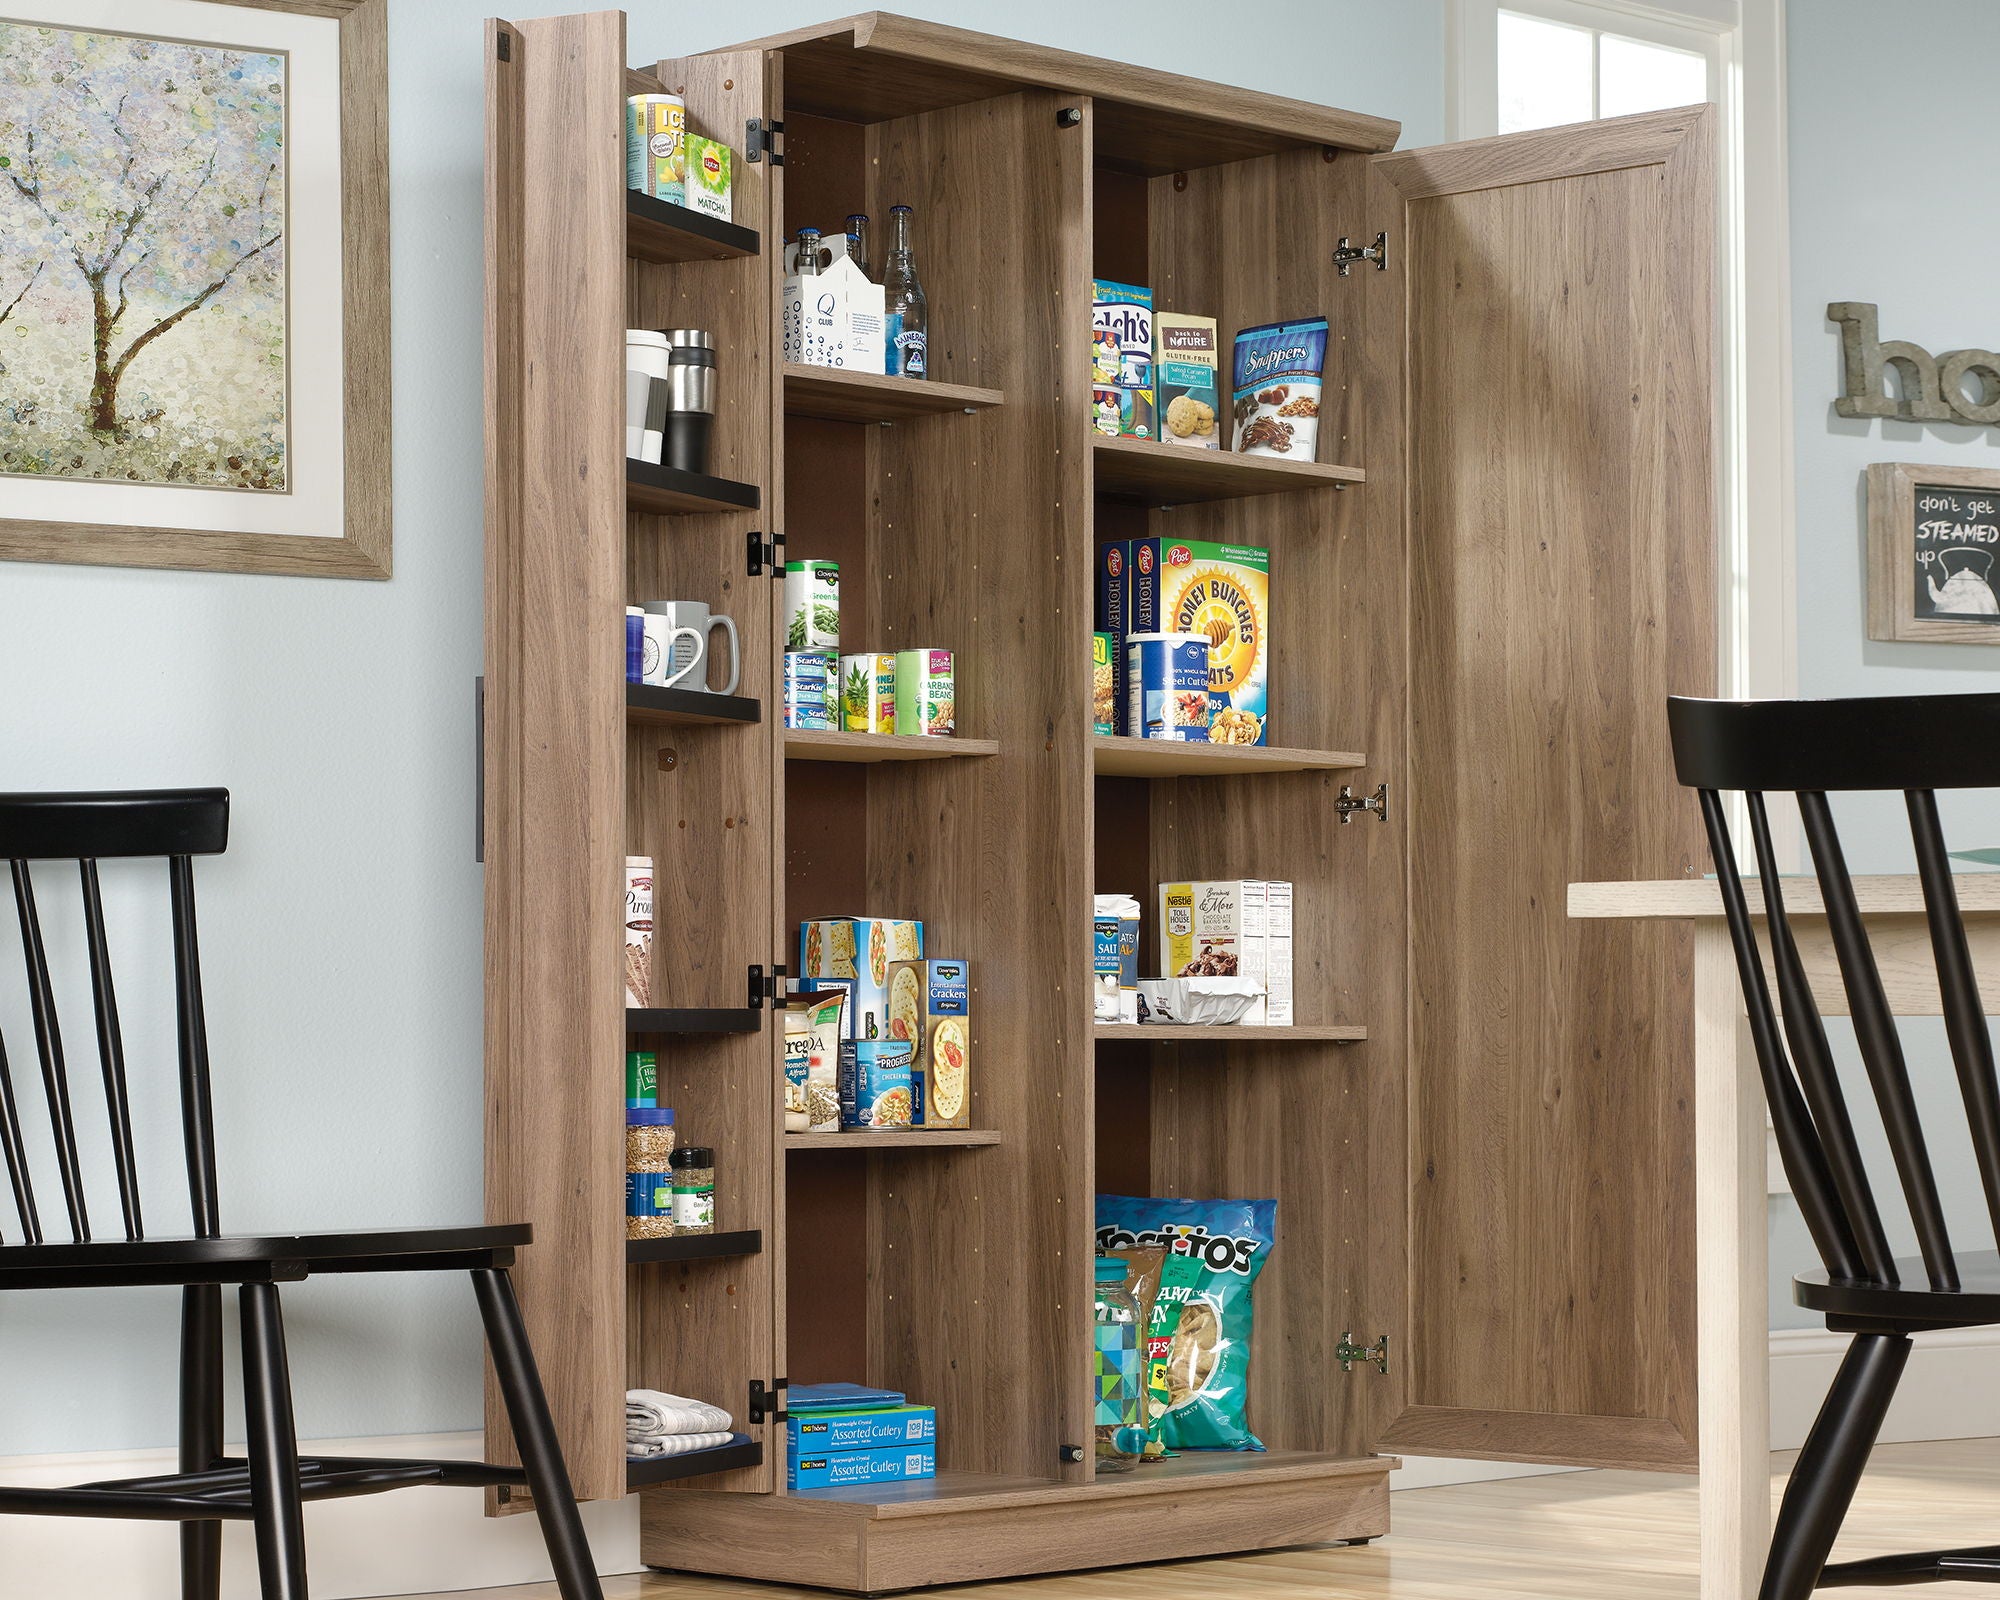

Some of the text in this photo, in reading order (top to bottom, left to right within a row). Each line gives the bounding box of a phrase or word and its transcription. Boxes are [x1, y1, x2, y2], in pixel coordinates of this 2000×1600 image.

[697, 197, 726, 215] MATCHA
[817, 293, 835, 317] Q
[1245, 346, 1307, 375] Snappers
[1919, 495, 1995, 520] don't get
[1916, 520, 1999, 543] STEAMED
[1111, 552, 1120, 573] Post
[1141, 549, 1150, 571] Post
[1171, 548, 1189, 564] Post
[1915, 550, 1936, 570] up
[1109, 580, 1121, 628] HONEY
[1140, 577, 1152, 627] HONEY
[1211, 580, 1254, 644] BUNCHES
[1187, 677, 1200, 686] Cut
[929, 690, 952, 700] BEANS
[1170, 916, 1190, 924] HOUSE
[1098, 943, 1117, 954] SALT
[930, 988, 967, 999] Crackers
[832, 1424, 903, 1440] Assorted Cutlery
[908, 1422, 921, 1431] 108
[830, 1460, 901, 1477] Assorted Cutlery
[907, 1458, 920, 1467] 108
